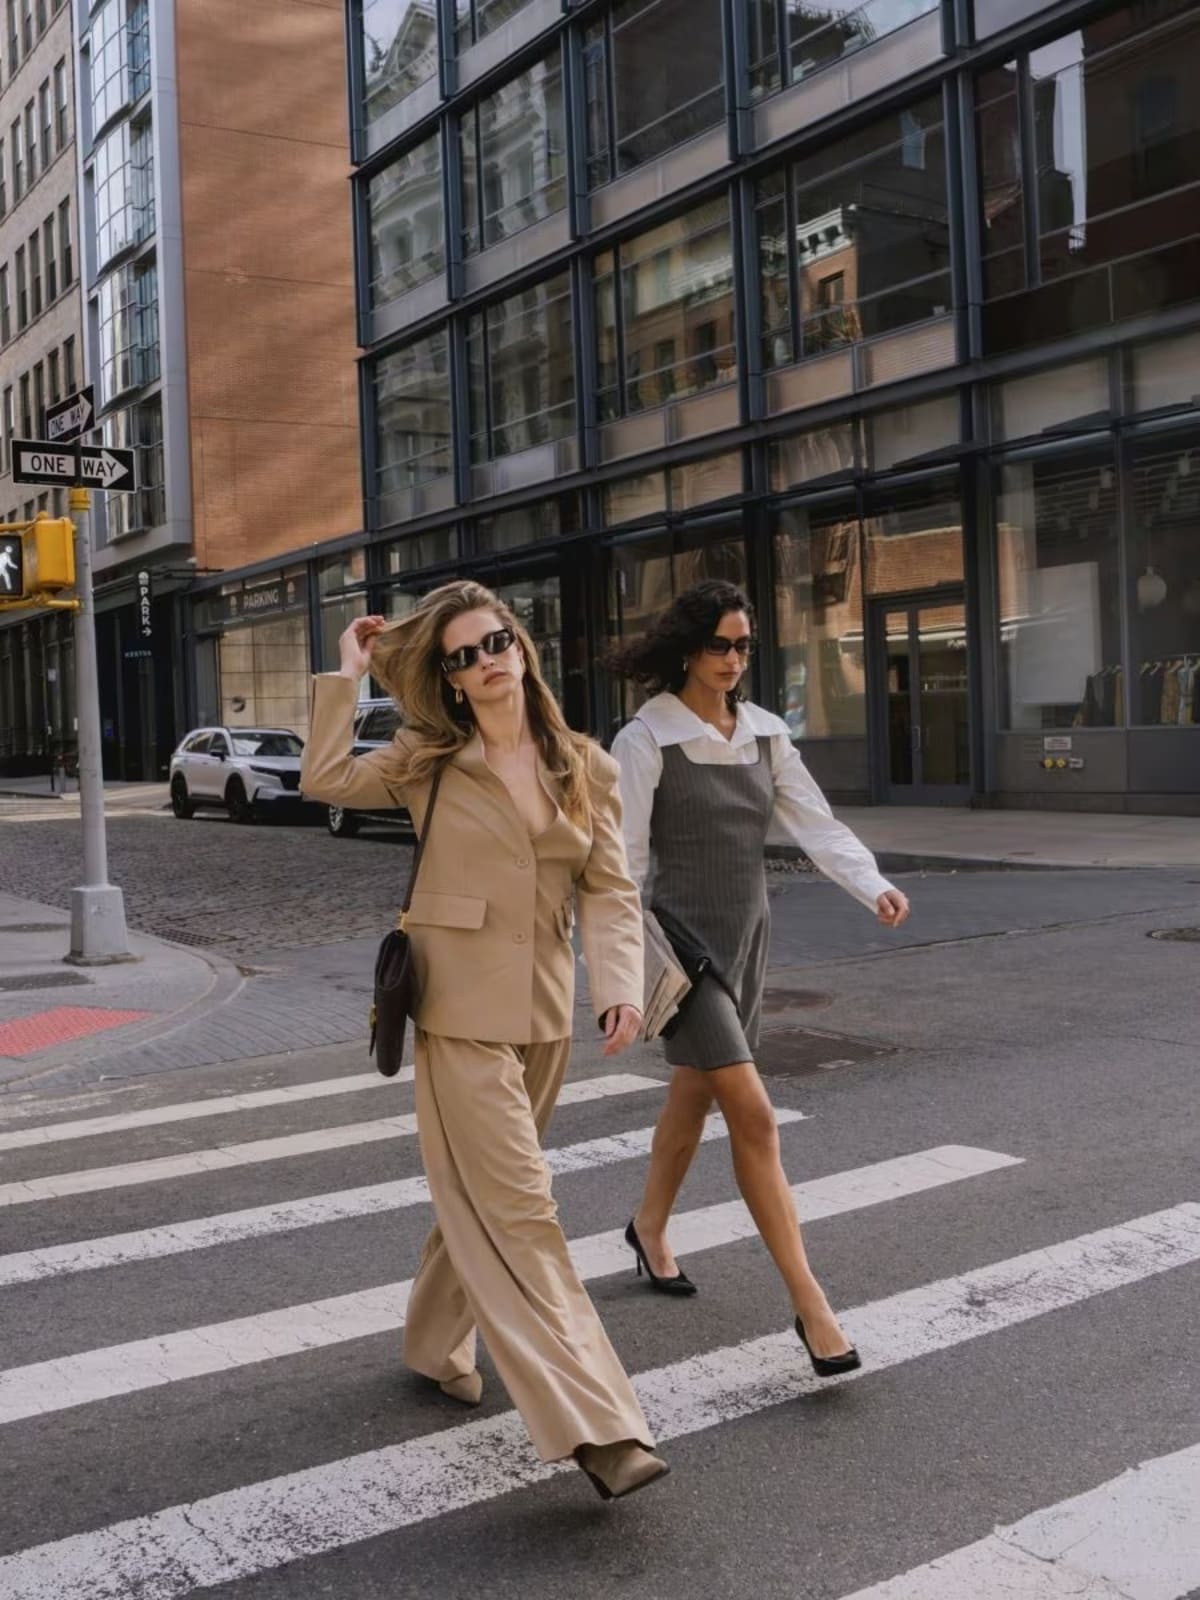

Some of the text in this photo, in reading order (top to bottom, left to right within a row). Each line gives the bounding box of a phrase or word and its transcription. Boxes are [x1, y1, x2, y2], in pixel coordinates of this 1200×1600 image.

[51, 402, 85, 436] ONE WAY
[31, 455, 117, 478] ONE WAY
[140, 586, 151, 626] PARK
[243, 588, 279, 609] PARKING
